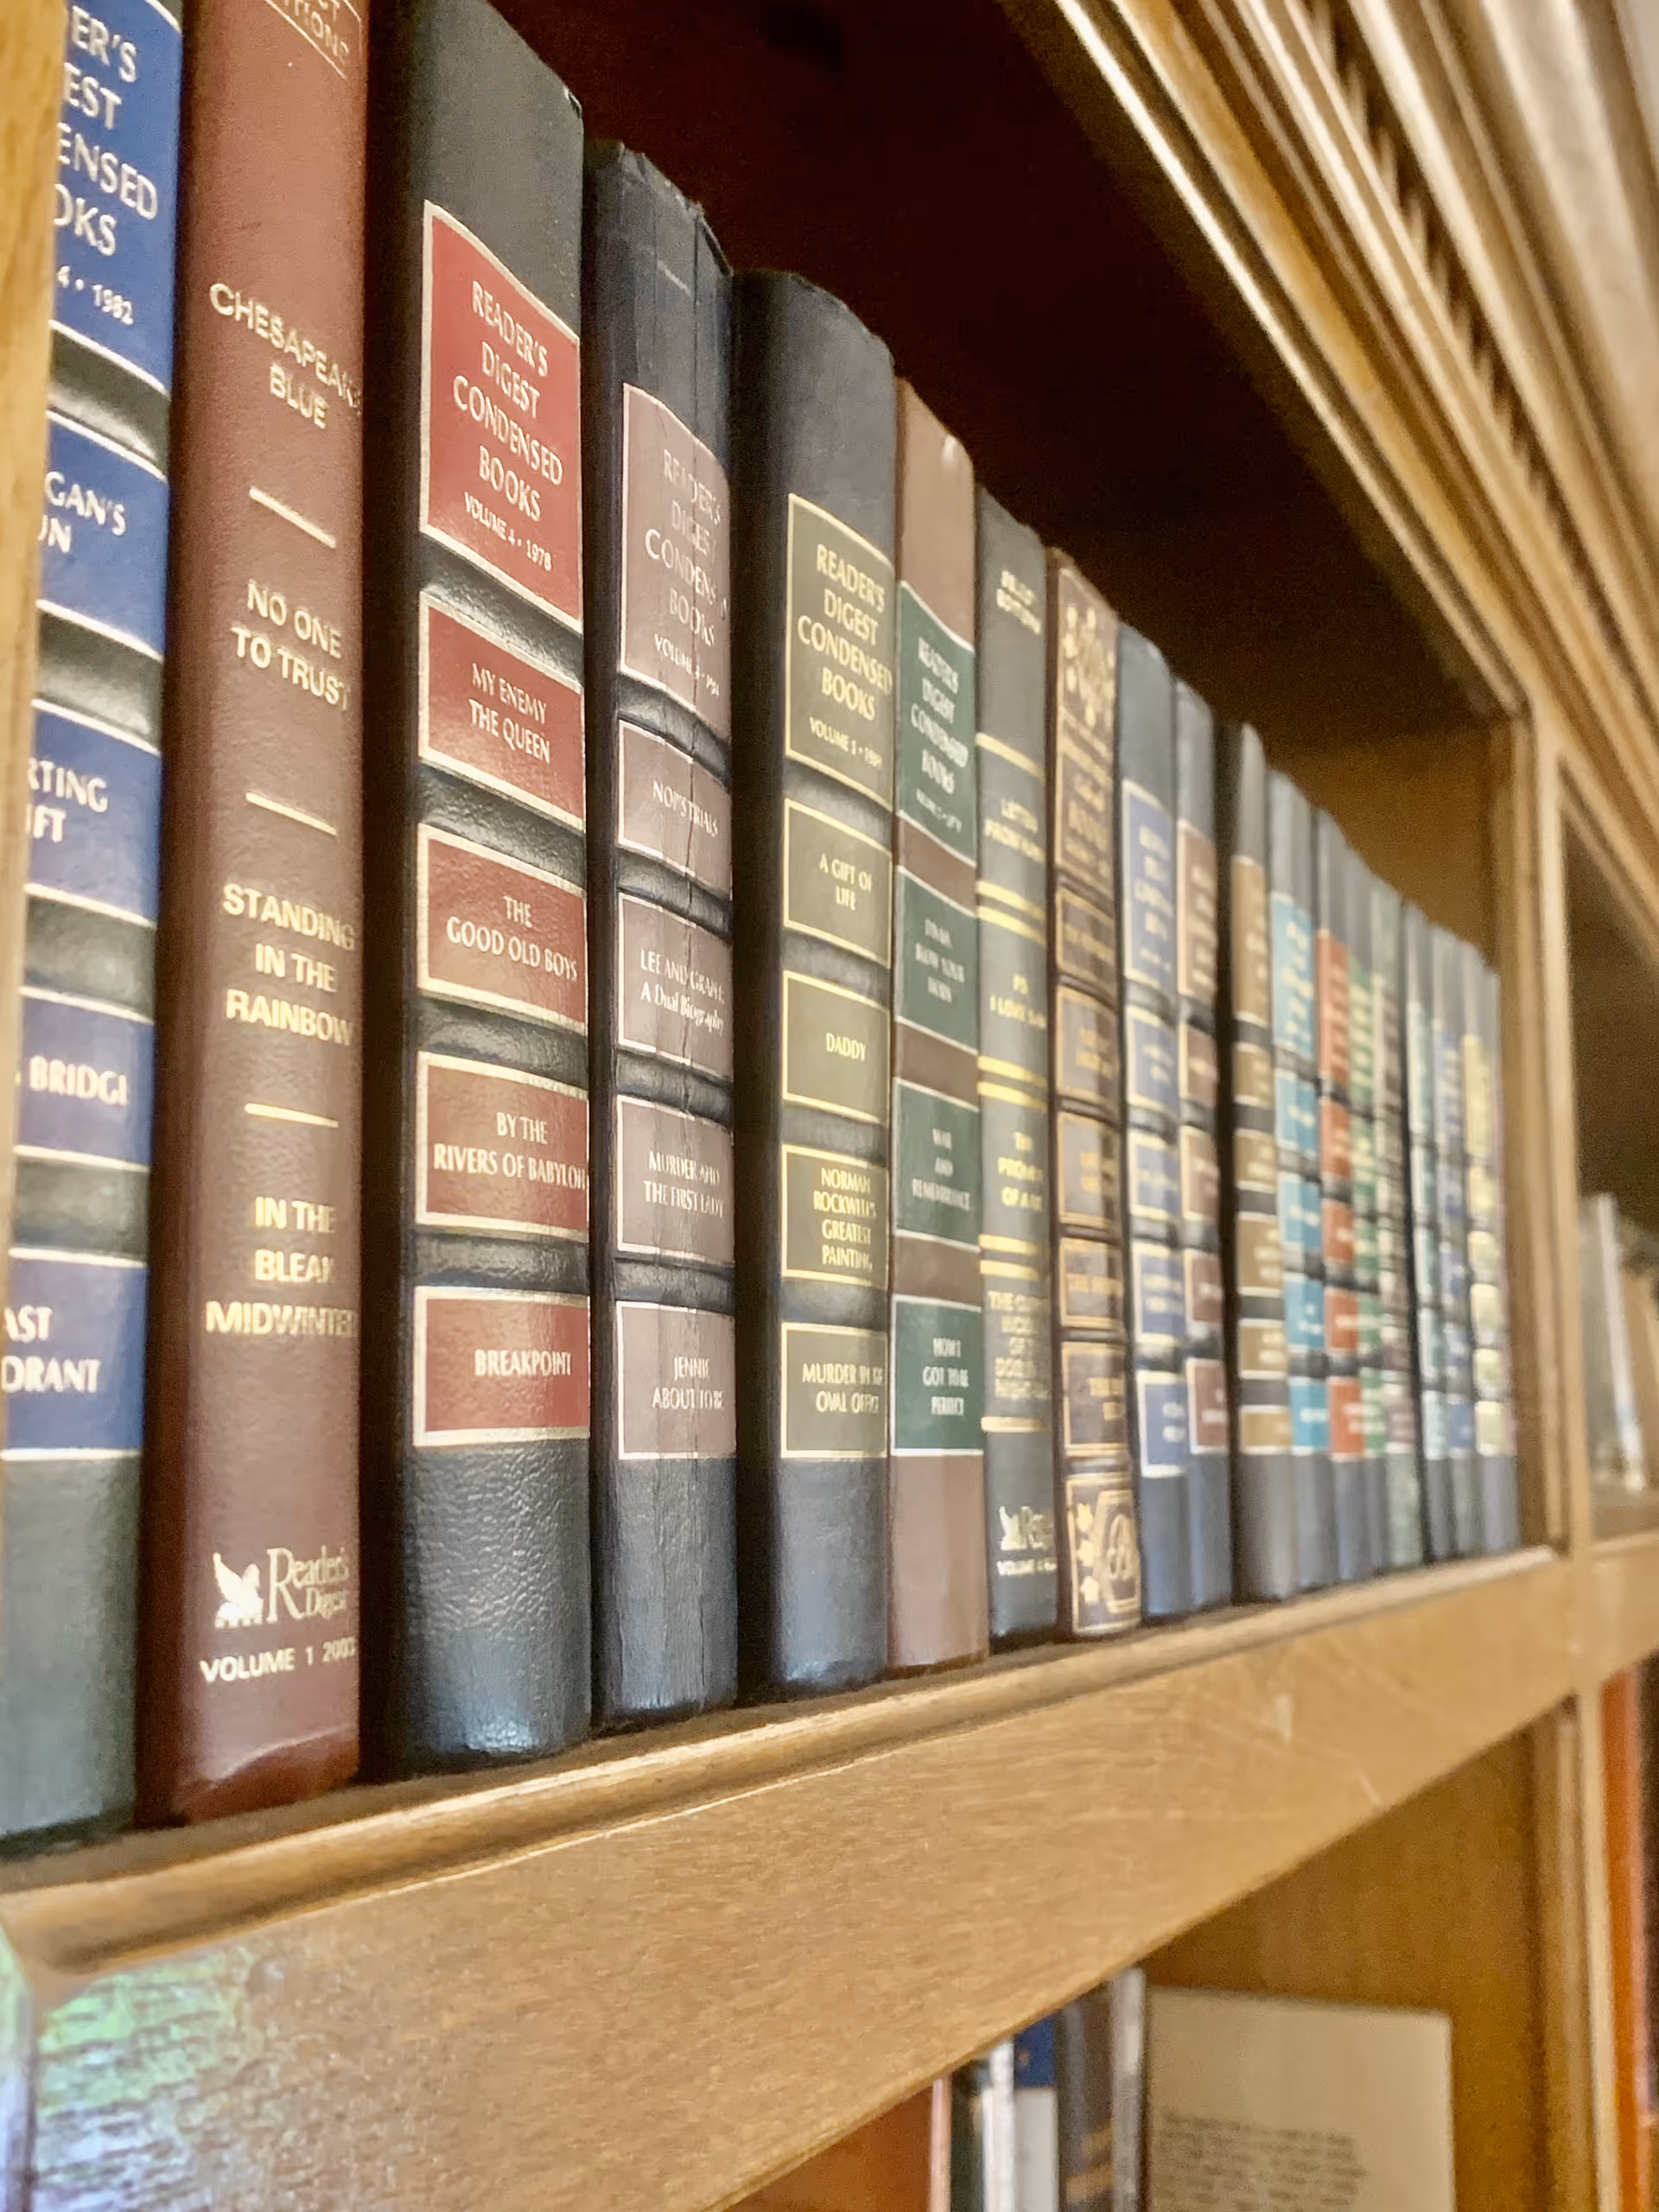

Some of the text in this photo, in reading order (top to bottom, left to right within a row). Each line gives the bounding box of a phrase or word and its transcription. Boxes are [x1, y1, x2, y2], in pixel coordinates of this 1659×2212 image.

[92, 284, 134, 325] 1982
[472, 280, 549, 378] READER'S
[270, 363, 327, 429] BLUE
[481, 340, 541, 419] DIGEST
[453, 375, 563, 486] CONDENSED
[45, 471, 127, 537] GAN'S
[479, 444, 541, 523] BOOKS
[464, 491, 507, 542] VOLUME
[816, 543, 886, 613] READER'S
[247, 580, 343, 659] NO ONE
[823, 588, 879, 646] DIGEST
[231, 625, 351, 711] TO TRUST
[797, 614, 893, 695] CONDENSED
[472, 662, 547, 725] MY ENEMY
[821, 666, 876, 721] BOOKS
[467, 697, 550, 763] THE QUEEN
[819, 853, 830, 874] A
[223, 882, 355, 950] STANDING
[503, 895, 534, 929] THE
[255, 943, 337, 994] IN THE
[446, 915, 578, 982] GOOD OLD BOYS
[640, 949, 662, 975] LEE
[226, 988, 353, 1046] RAINBOW
[640, 981, 652, 1003] A
[826, 1033, 866, 1062] DADDY
[497, 1111, 549, 1145] BY THE
[434, 1142, 587, 1190] RIVERS OF BABYLON
[821, 1166, 871, 1194] NORMAN
[255, 1197, 336, 1234] IN THE
[643, 1180, 669, 1206] THE
[474, 1348, 572, 1378] BREAKPOINT
[802, 1362, 857, 1385] MURDER
[652, 1386, 696, 1411] ABOUT
[200, 1647, 296, 1682] VOLUME
[305, 1645, 314, 1666] 1
